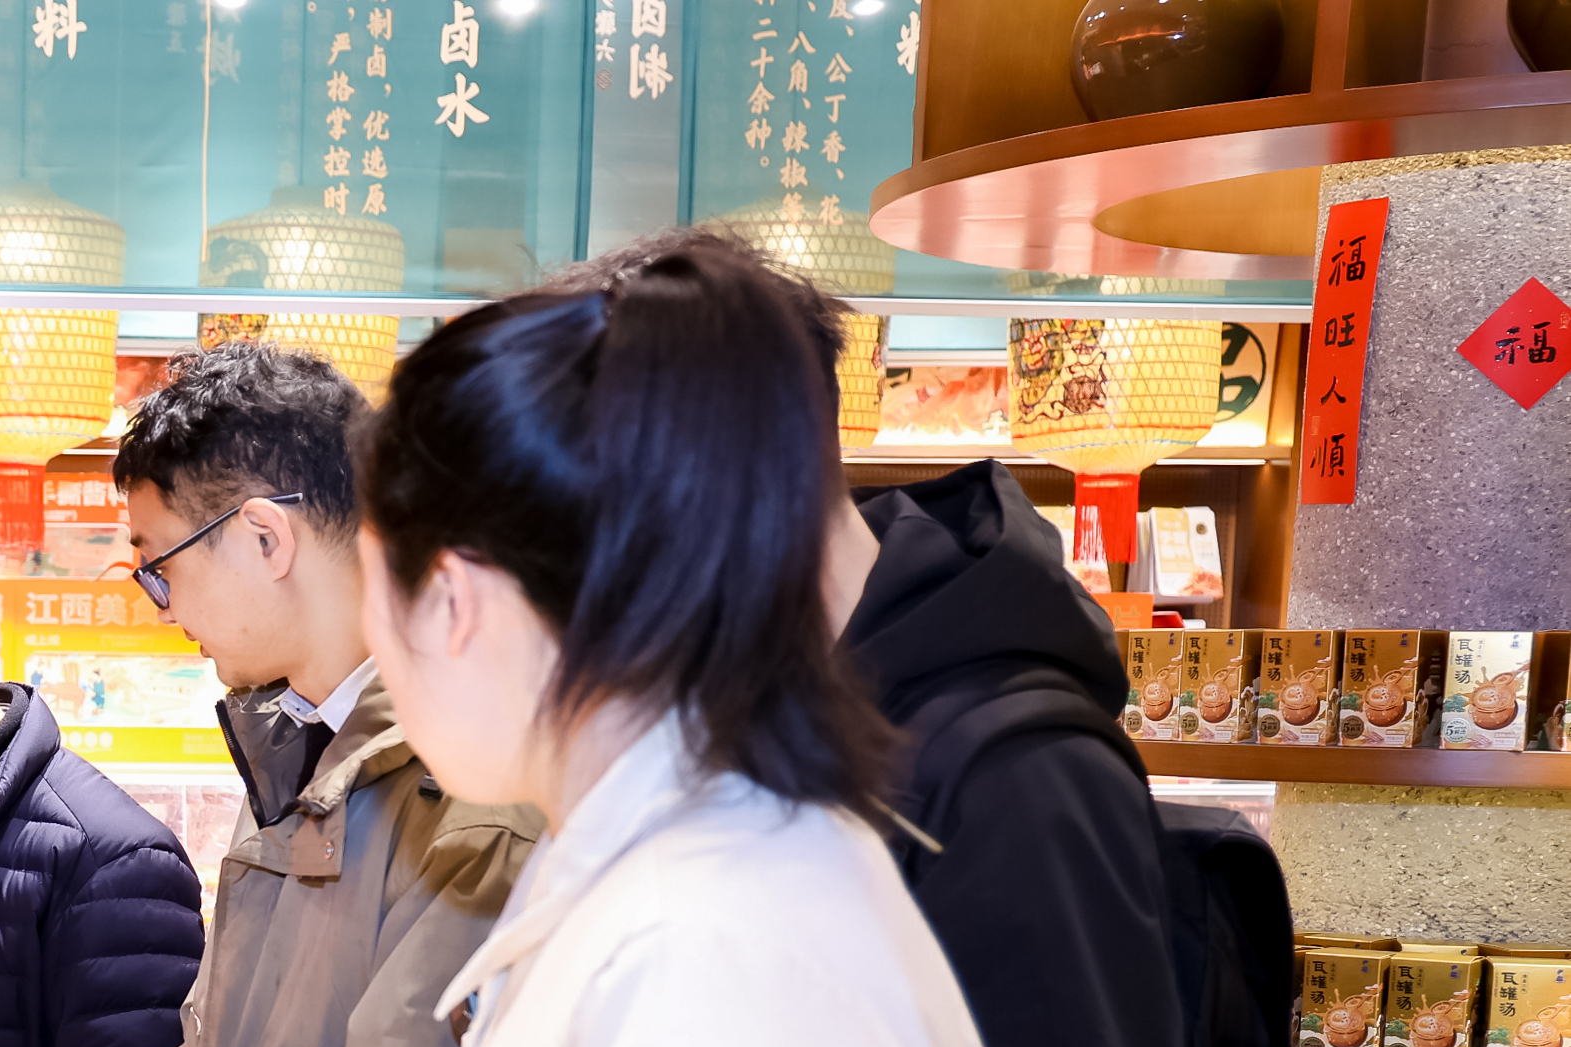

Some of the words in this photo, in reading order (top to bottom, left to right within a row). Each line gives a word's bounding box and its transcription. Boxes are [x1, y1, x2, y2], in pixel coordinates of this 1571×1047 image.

[434, 0, 490, 138] 卤水
[745, 0, 777, 167] 二十余种。
[1310, 235, 1367, 478] 福旺人順
[1494, 321, 1557, 366] 福
[1132, 637, 1145, 679] 瓦罐汤
[1188, 637, 1201, 680] 瓦罐汤
[1267, 637, 1284, 682] 瓦罐汤
[1350, 637, 1367, 682] 瓦罐汤
[1455, 638, 1475, 684] 瓦罐汤
[1310, 961, 1328, 1005] 瓦罐汤
[1396, 965, 1414, 1011] 瓦罐汤
[1499, 972, 1518, 1017] 瓦罐汤
